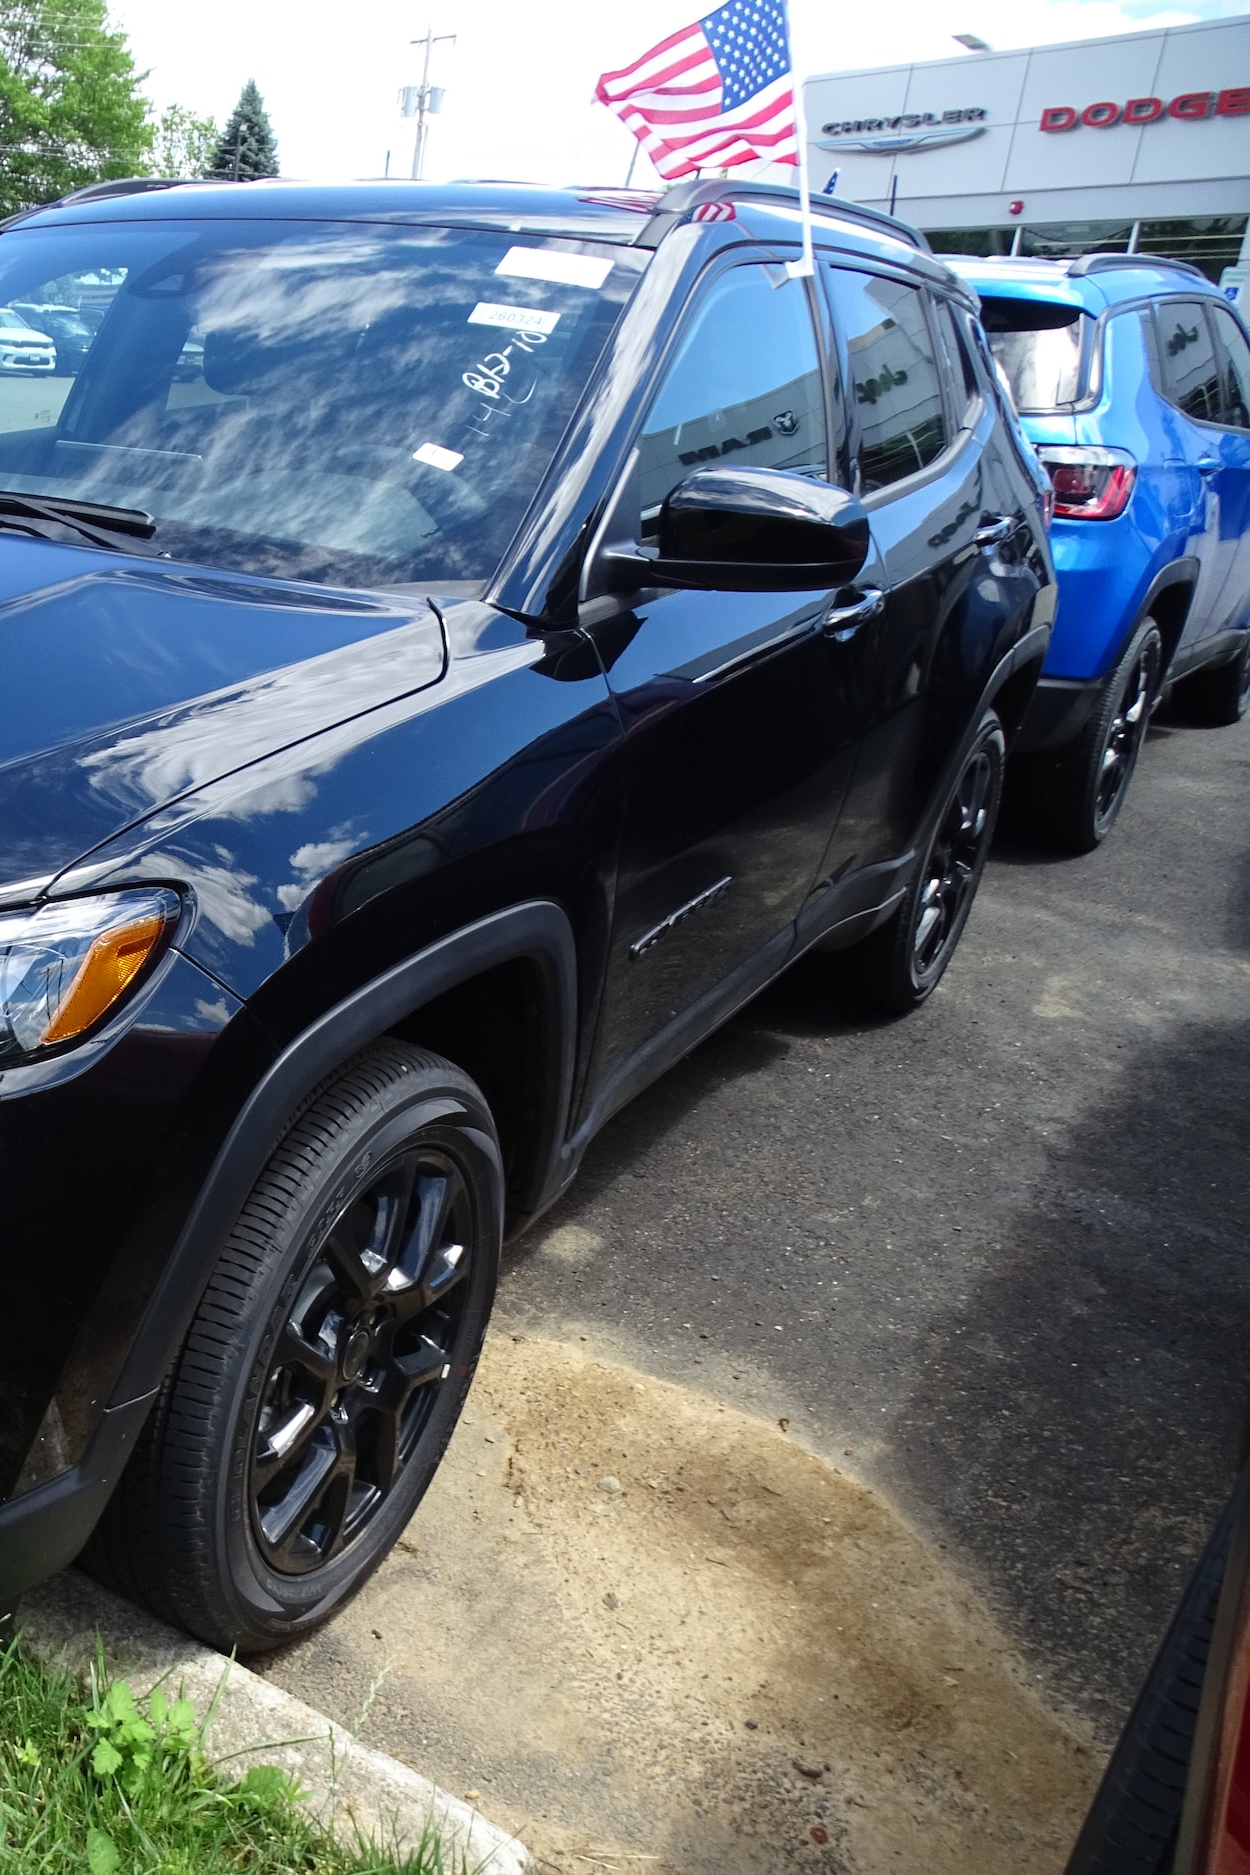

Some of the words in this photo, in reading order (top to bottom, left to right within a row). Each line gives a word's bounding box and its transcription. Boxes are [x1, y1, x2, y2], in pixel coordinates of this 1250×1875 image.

[822, 107, 987, 136] CHRYSLER
[1039, 87, 1250, 131] DODGE
[488, 310, 543, 326] 260324
